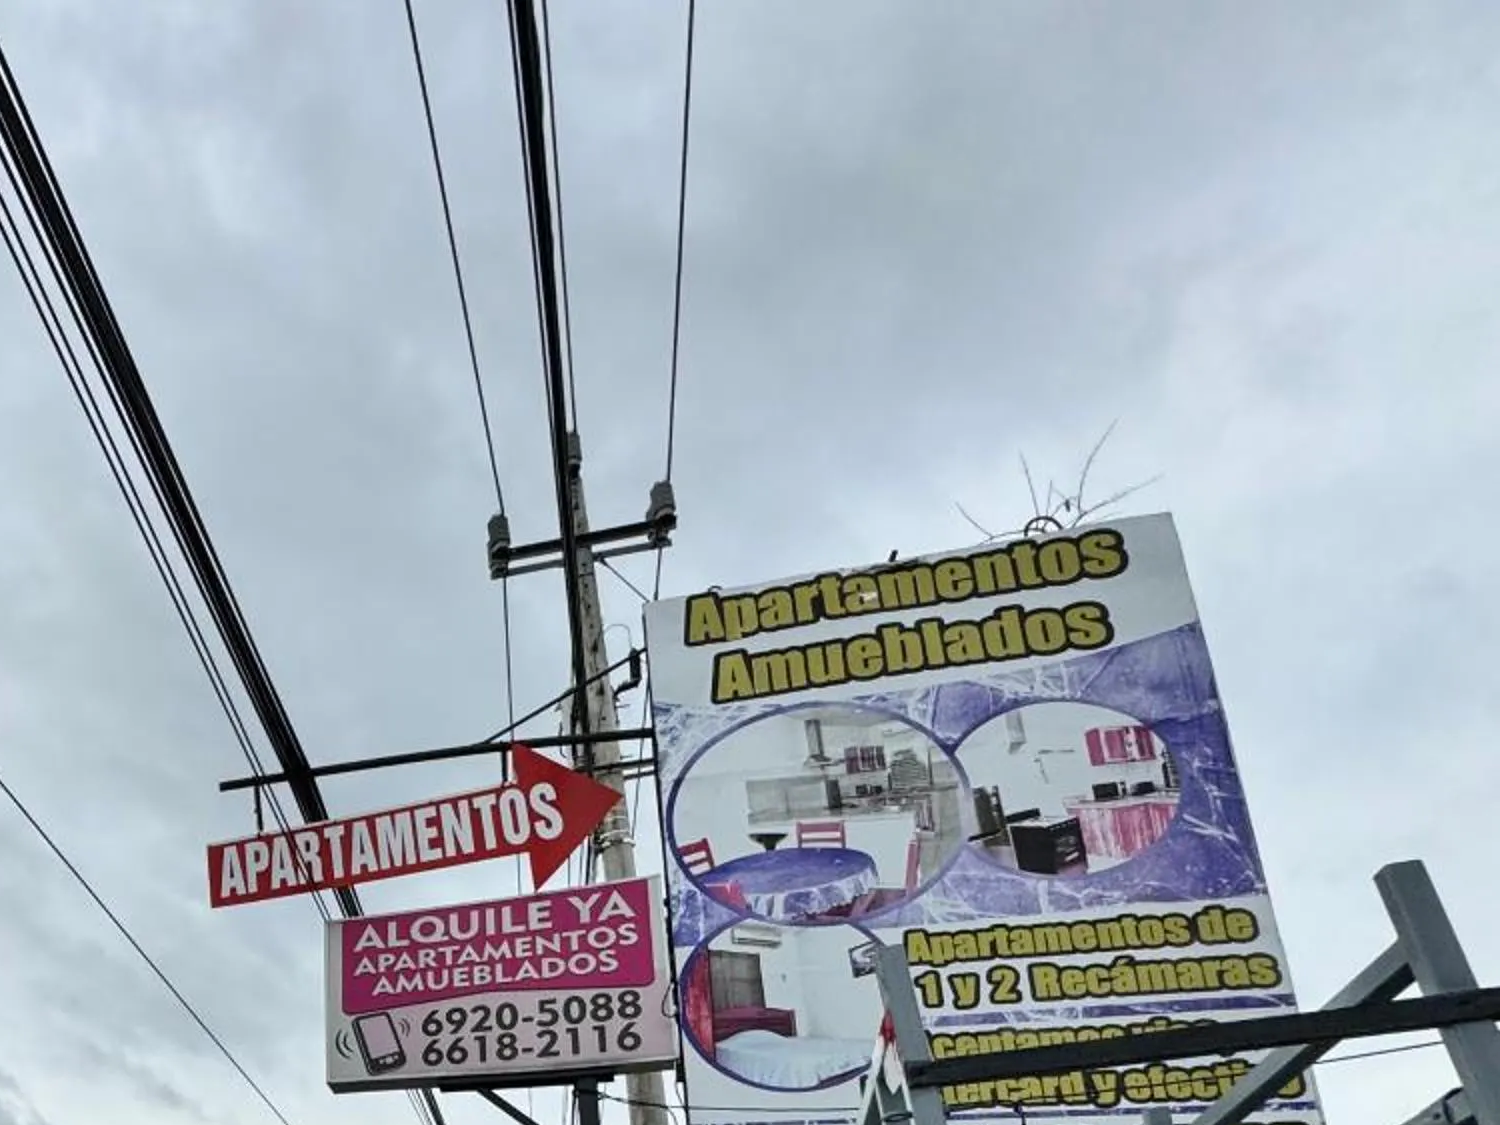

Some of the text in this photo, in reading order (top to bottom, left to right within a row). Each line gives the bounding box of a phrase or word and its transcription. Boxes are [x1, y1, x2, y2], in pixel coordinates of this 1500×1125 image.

[684, 529, 1129, 646] Apartamentos
[711, 601, 1114, 703] Amueblados
[220, 782, 565, 899] APARTAMENTOS
[354, 891, 638, 951] ALQUILE YA
[354, 922, 639, 977] APARTAMENTOS
[902, 906, 1259, 966] Apartamentos de
[372, 950, 620, 996] AMUEBLADOS
[915, 951, 1281, 1010] 1 y 2 Recámaras
[421, 990, 643, 1037] 6920-5088
[421, 1022, 642, 1067] 6618-2116
